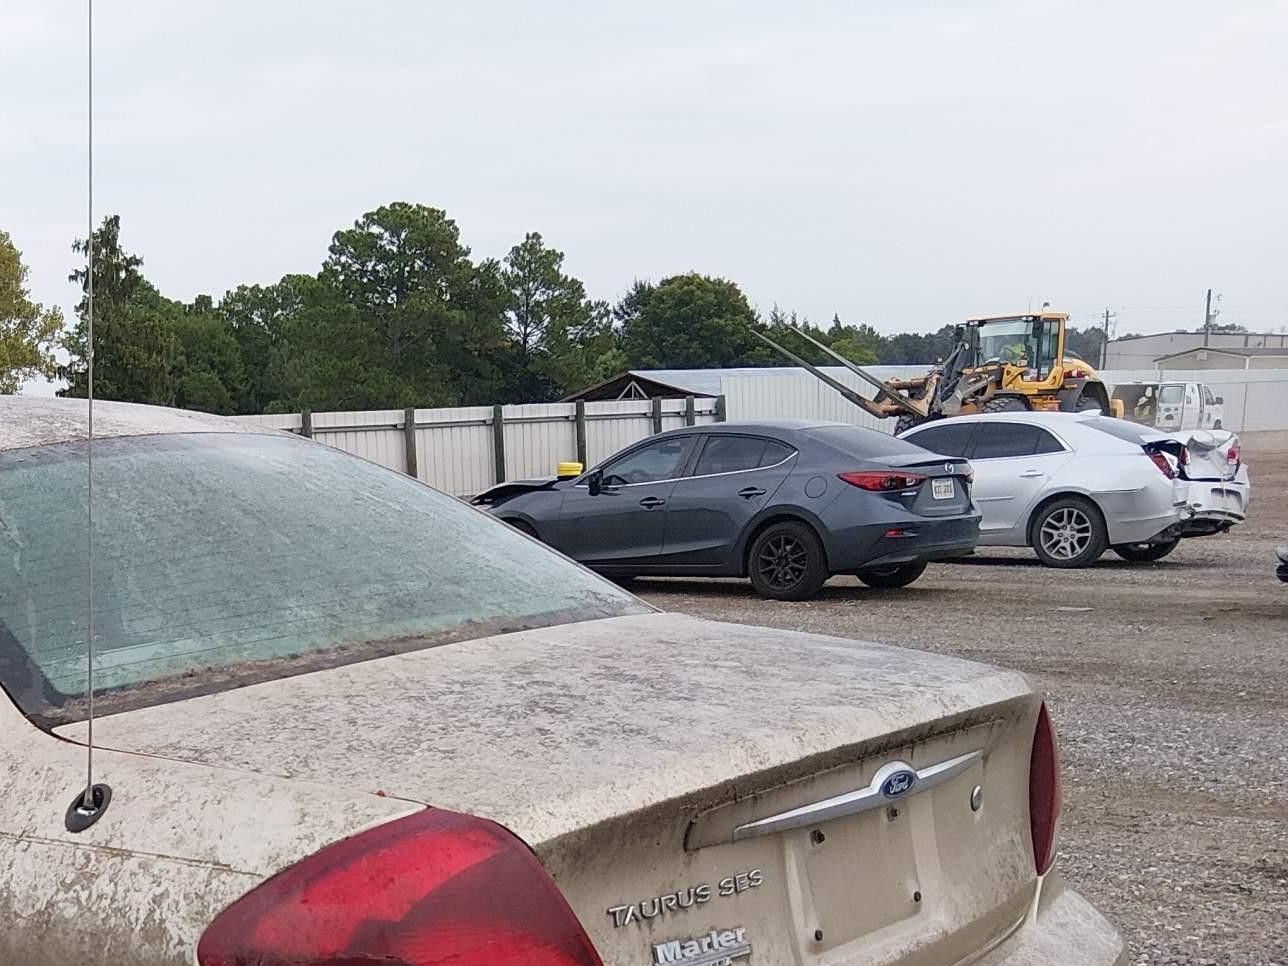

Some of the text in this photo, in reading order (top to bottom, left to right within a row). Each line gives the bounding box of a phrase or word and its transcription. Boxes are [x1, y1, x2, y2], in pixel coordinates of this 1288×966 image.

[889, 773, 910, 794] Ford
[608, 869, 763, 928] TAURUS SES
[654, 927, 747, 965] Marler
